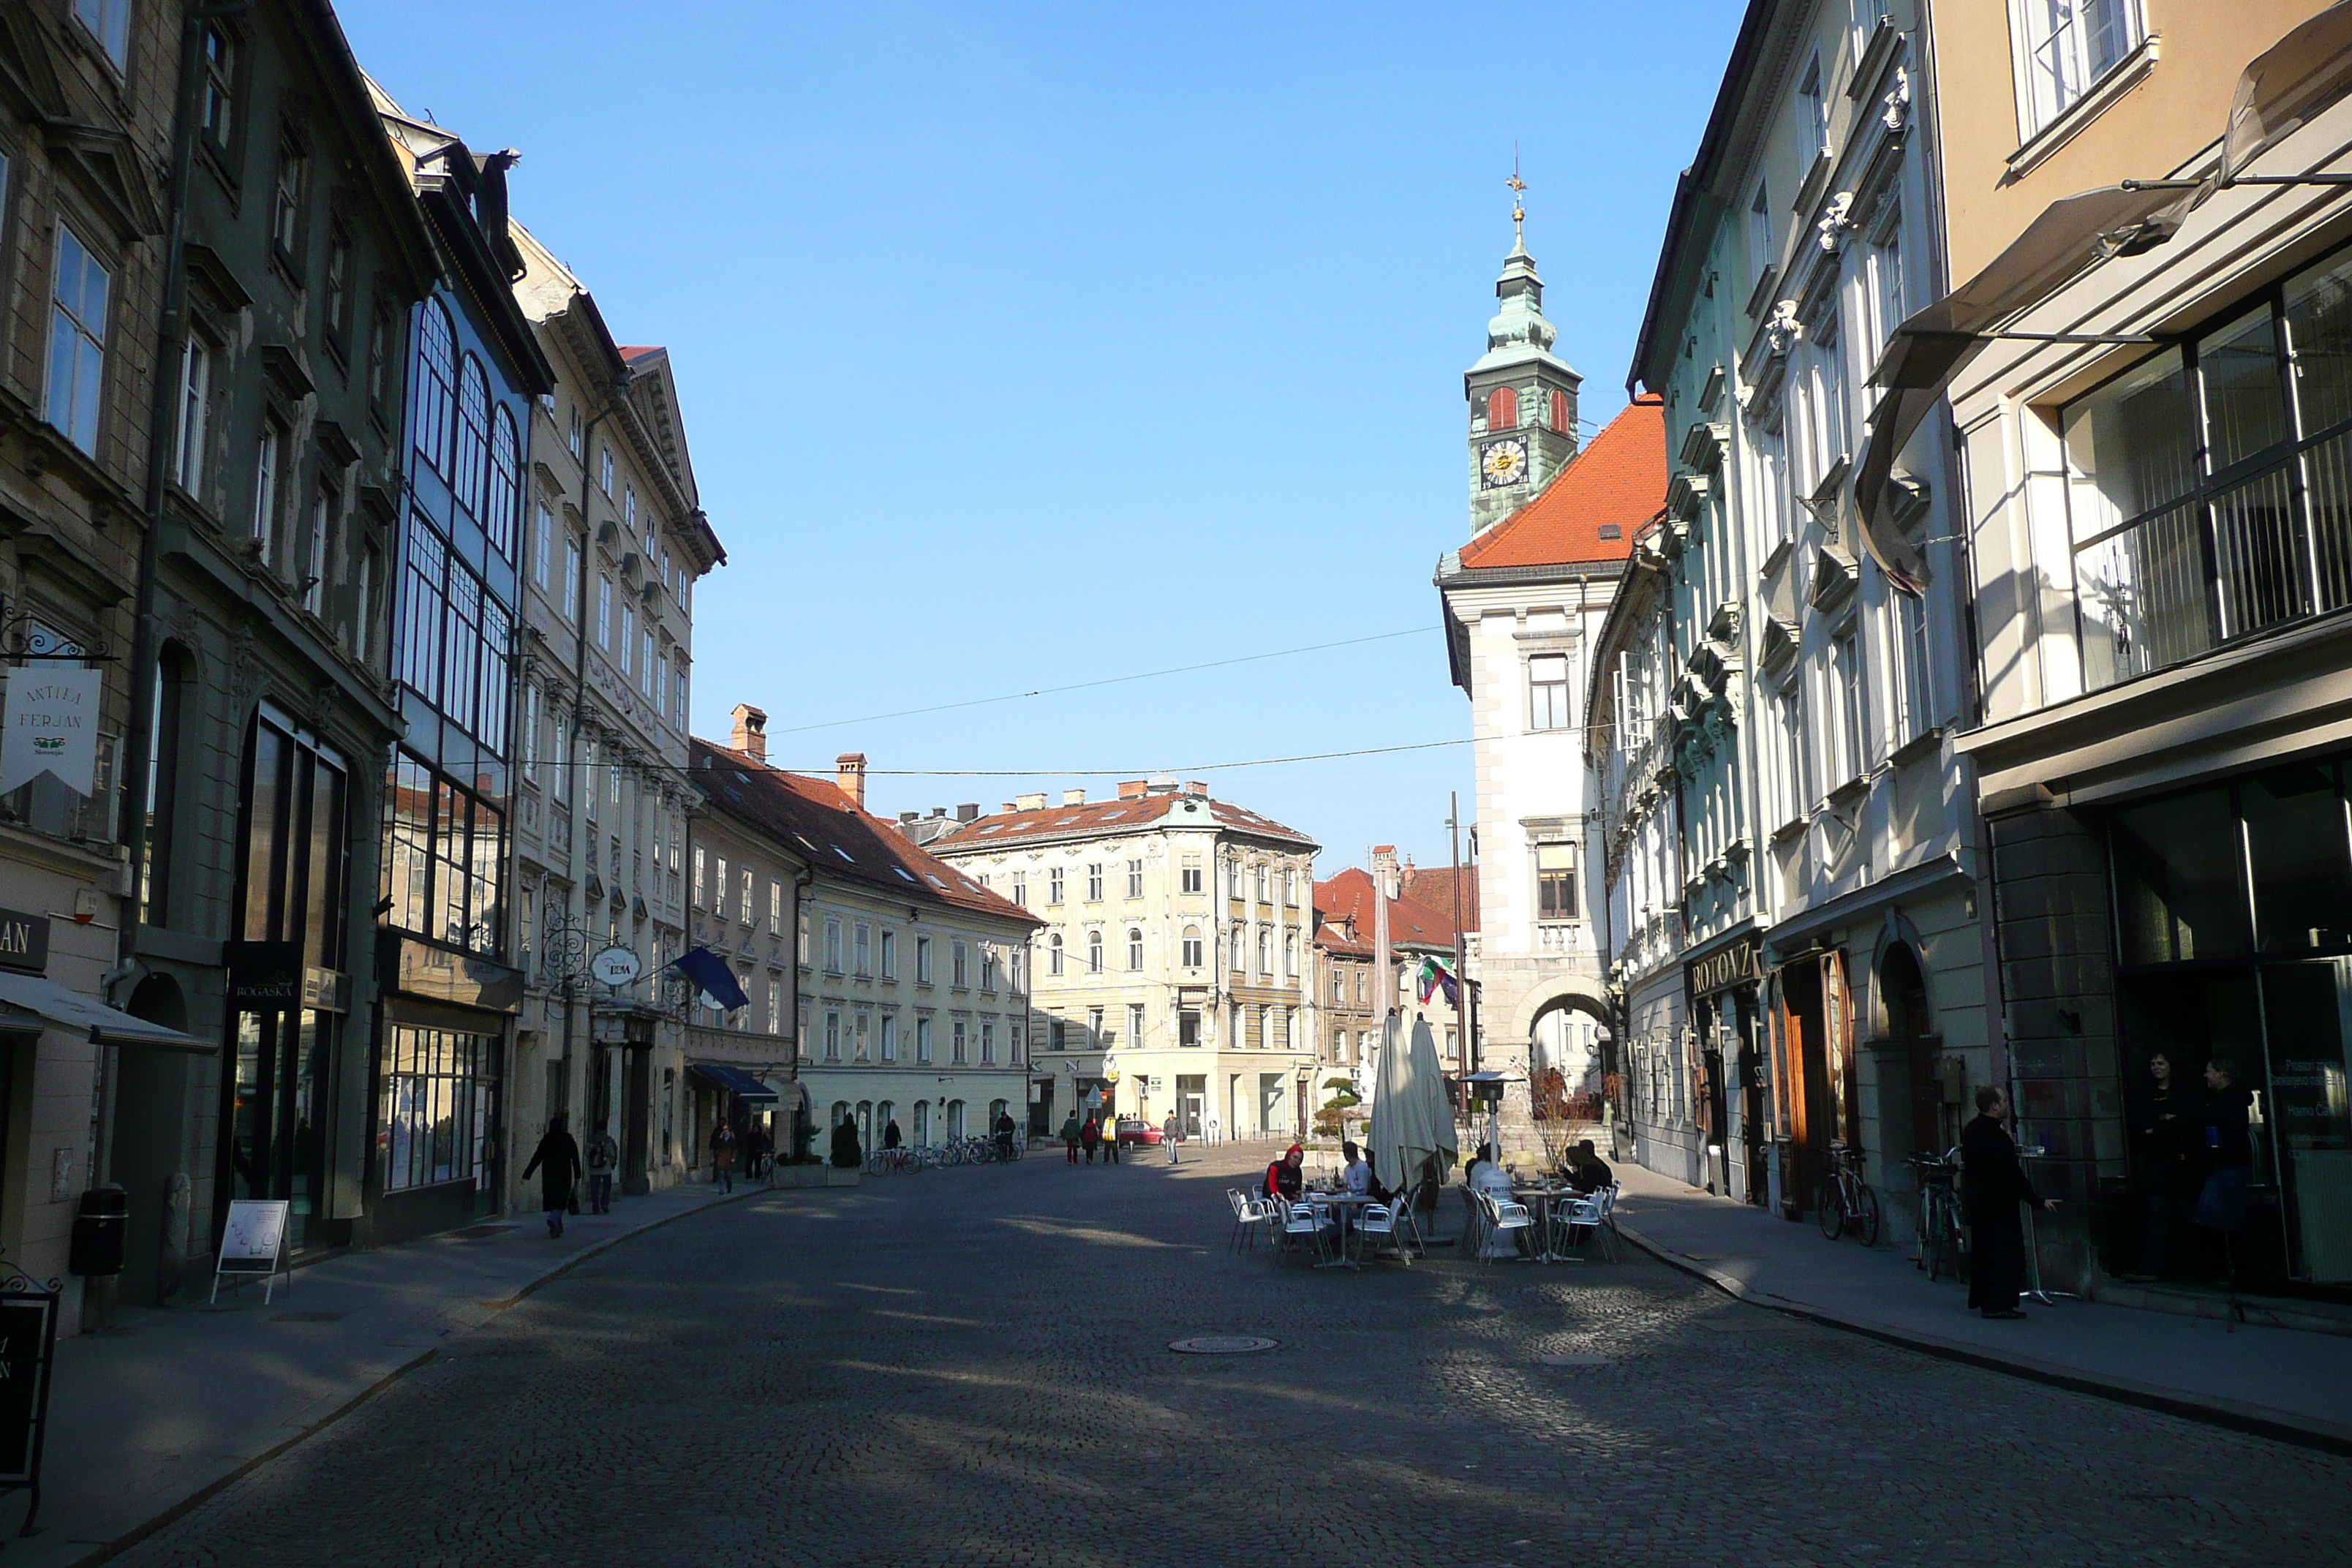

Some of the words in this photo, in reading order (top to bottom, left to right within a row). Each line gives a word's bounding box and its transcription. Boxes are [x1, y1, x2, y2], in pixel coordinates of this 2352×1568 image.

[26, 685, 82, 706] ANTIKA
[20, 713, 82, 728] FERJAN
[1692, 937, 1752, 995] ROTOVŽ
[2288, 1104, 2314, 1117] Hamo
